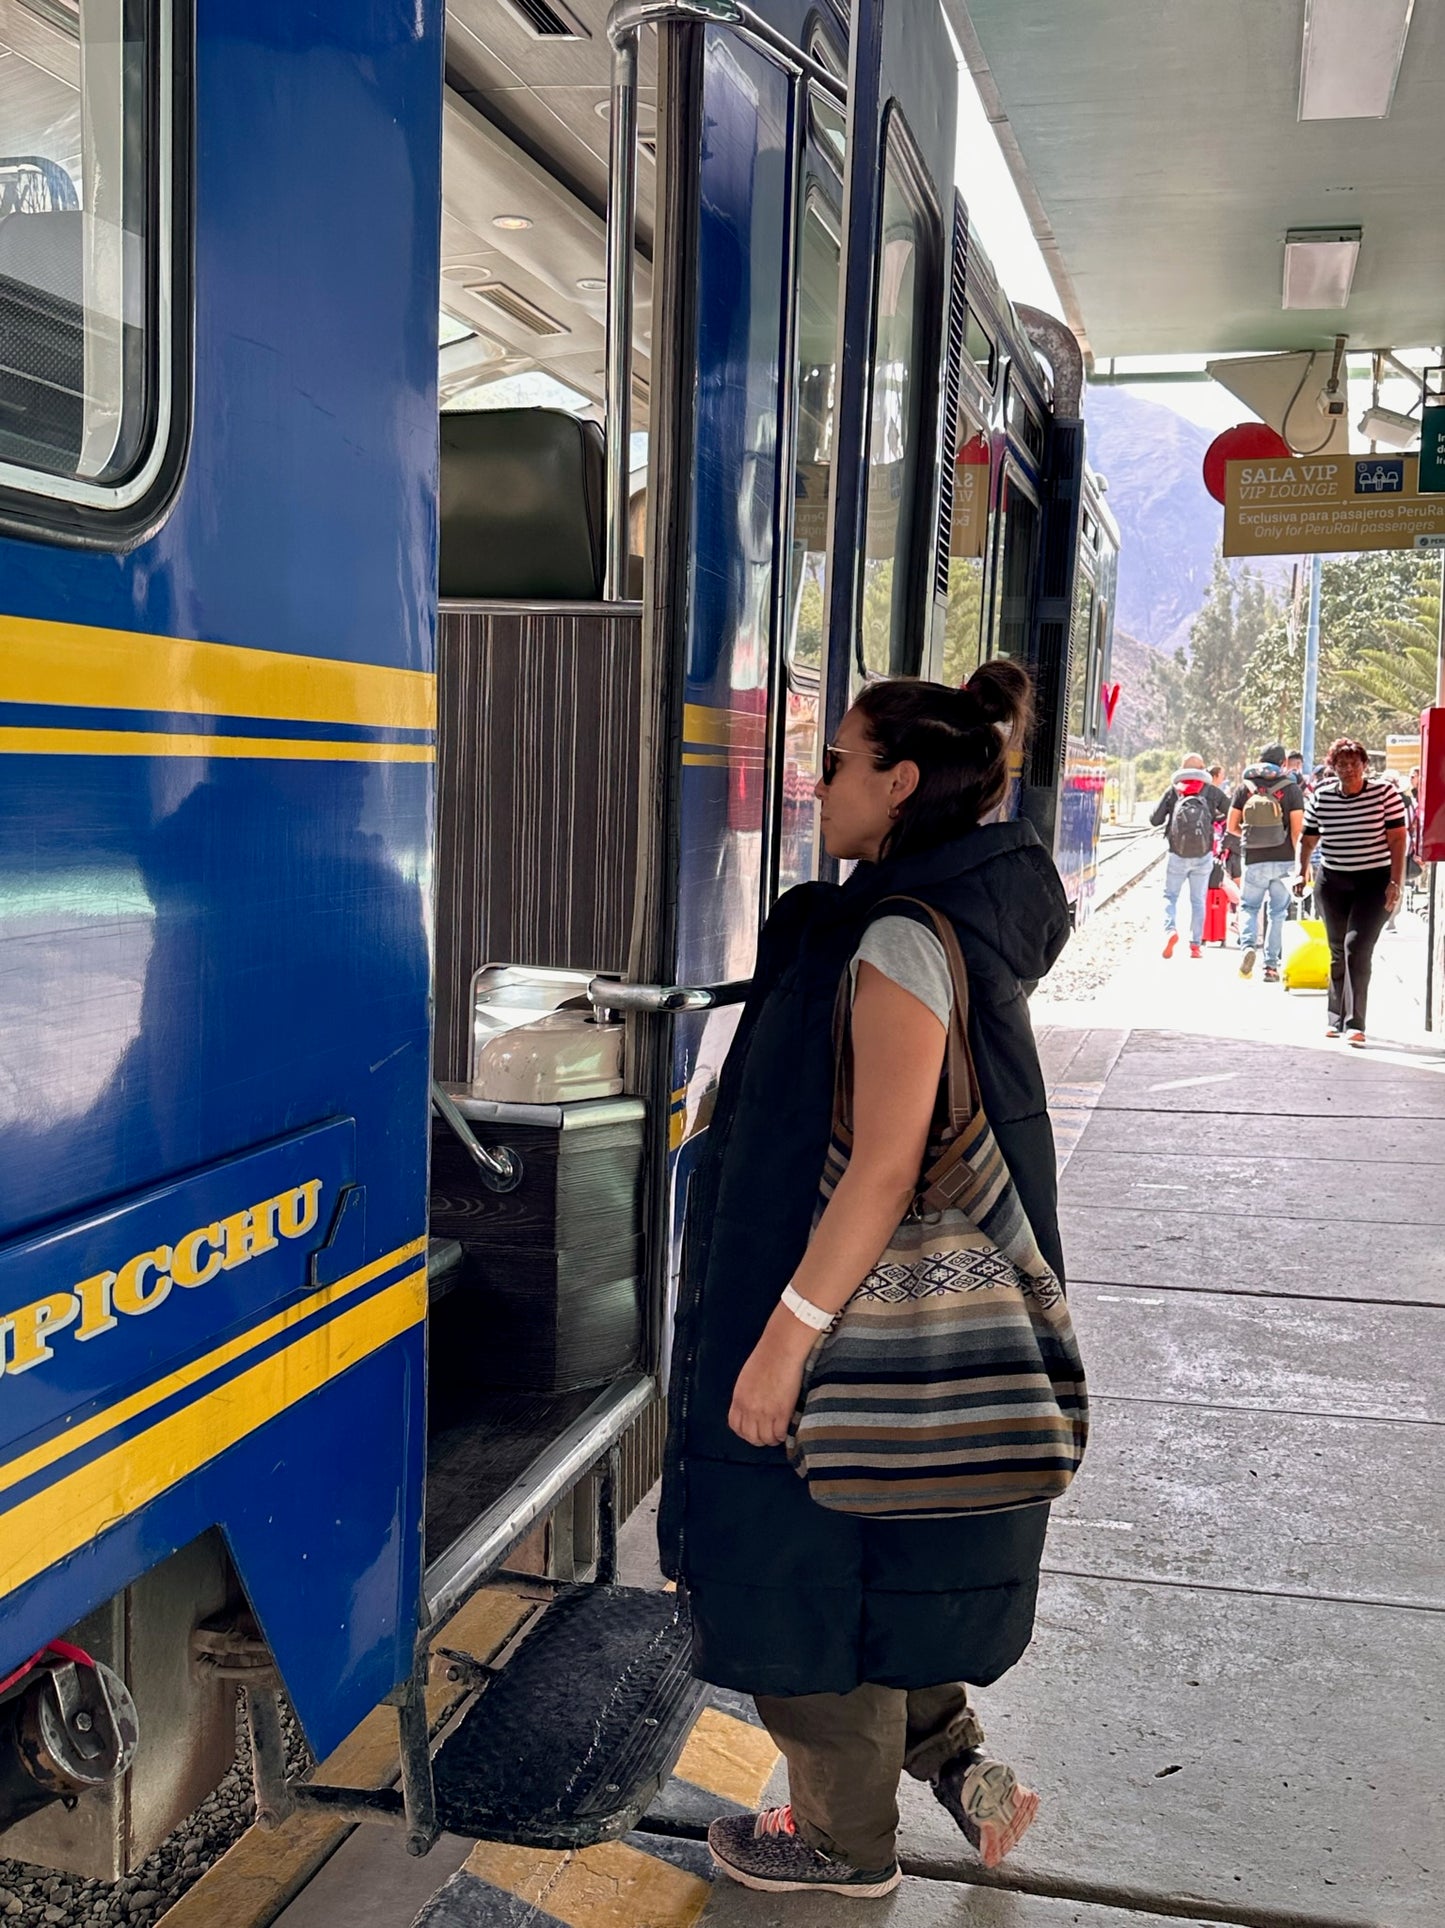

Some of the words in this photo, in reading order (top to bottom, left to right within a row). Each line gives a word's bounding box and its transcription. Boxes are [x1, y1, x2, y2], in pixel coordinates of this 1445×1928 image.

[1241, 467, 1296, 484] SALA
[1301, 465, 1338, 480] VIP
[1240, 486, 1265, 499] VIP
[1269, 483, 1337, 498] LOUNGE
[1239, 512, 1297, 525] Exclusiva
[1301, 512, 1328, 523] para
[1332, 508, 1394, 522] pasajeros
[1398, 504, 1445, 517] PeruRa
[1255, 526, 1282, 540] Only
[1286, 524, 1302, 536] for
[1305, 521, 1358, 536] PeruRail
[1360, 520, 1435, 535] passengers
